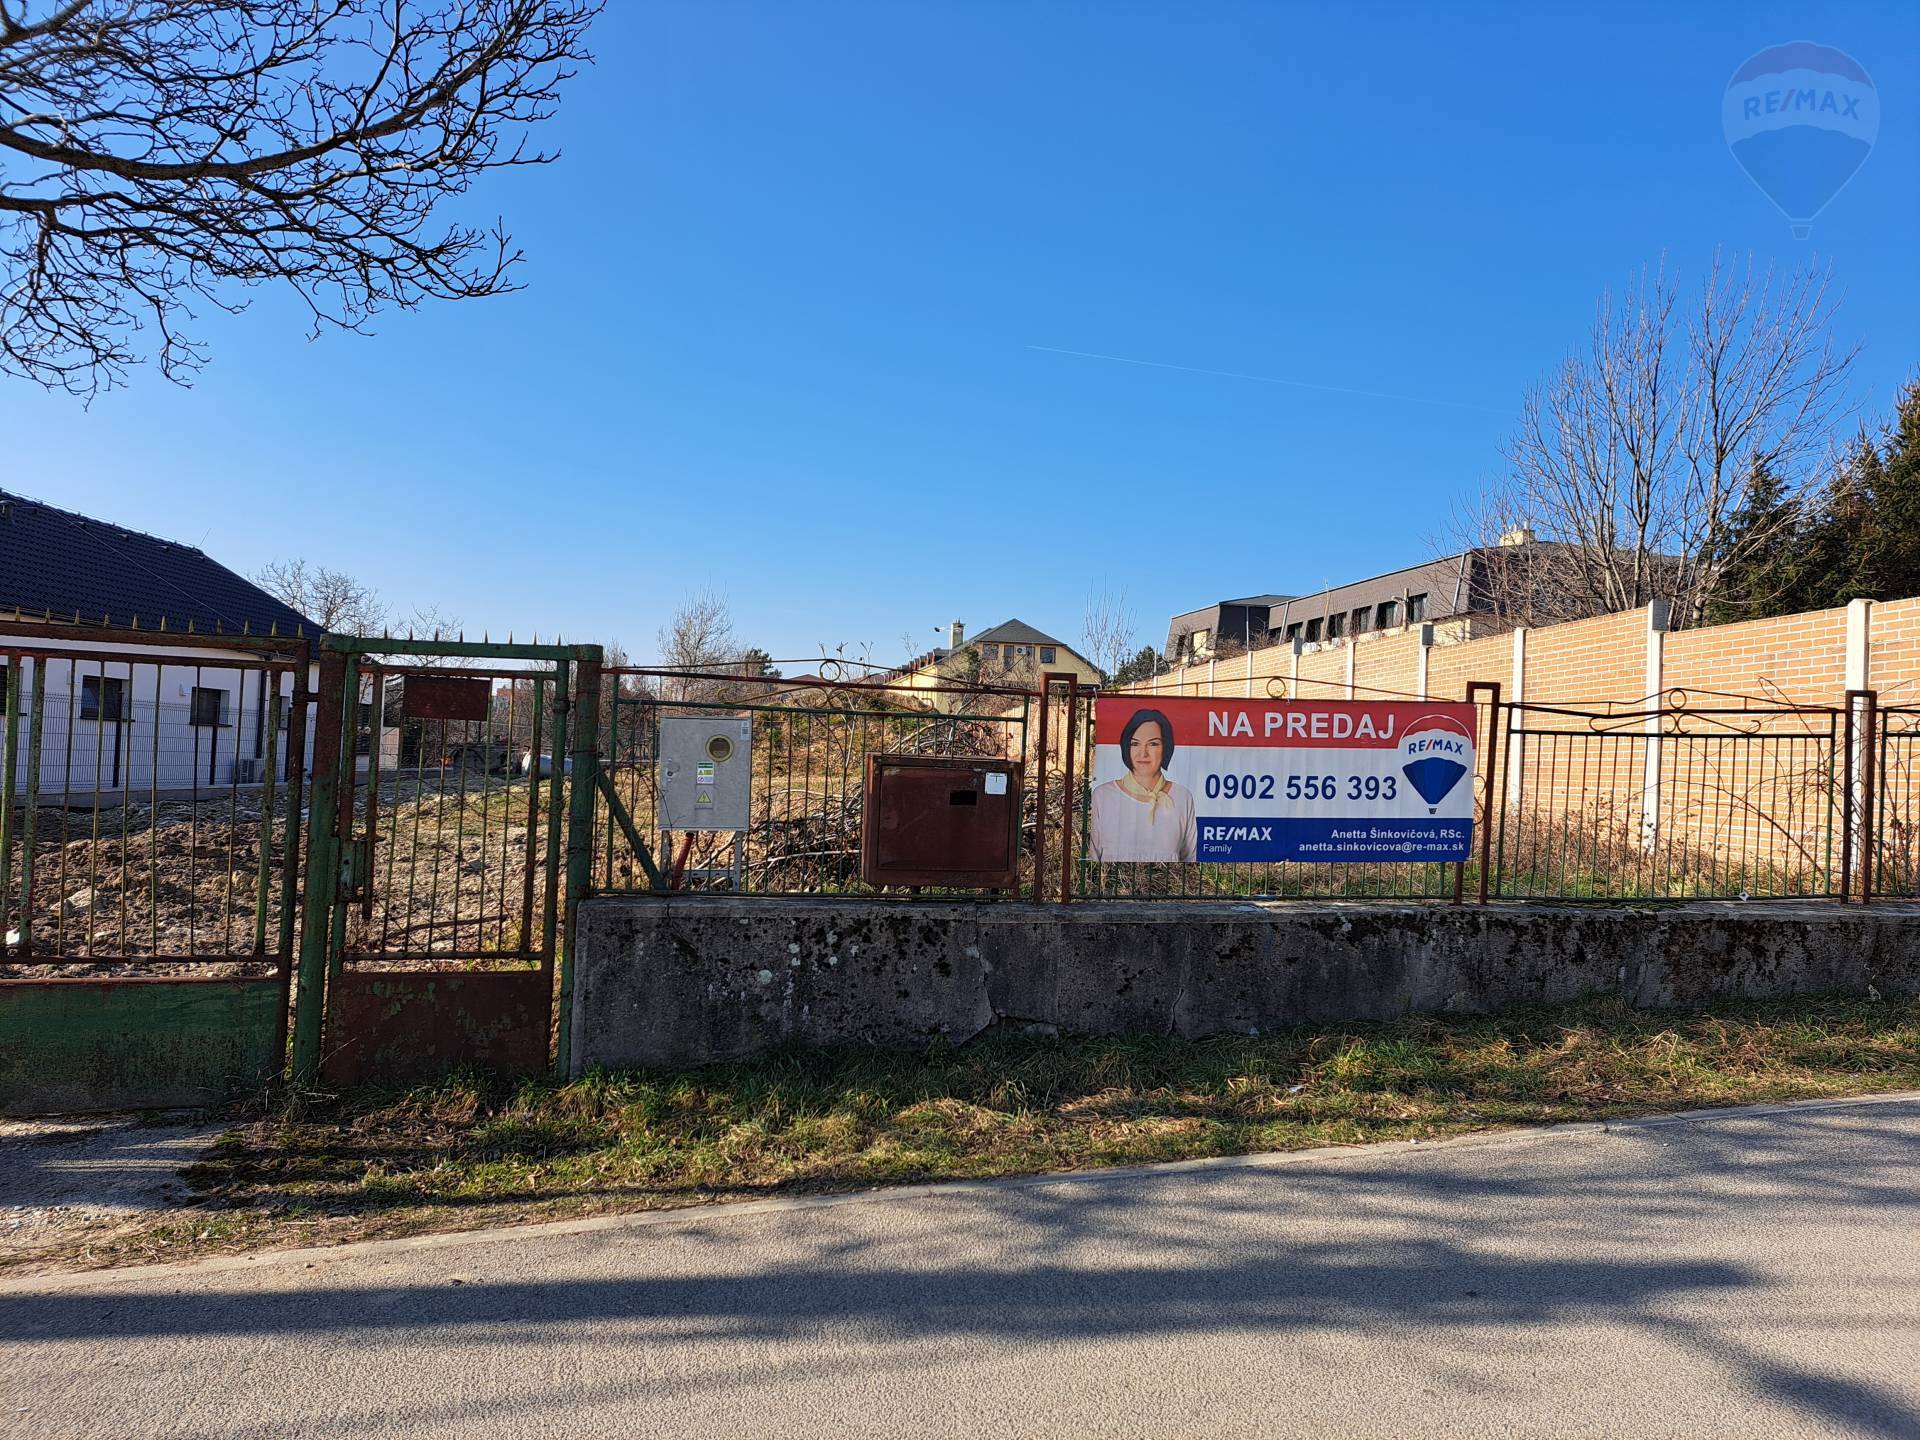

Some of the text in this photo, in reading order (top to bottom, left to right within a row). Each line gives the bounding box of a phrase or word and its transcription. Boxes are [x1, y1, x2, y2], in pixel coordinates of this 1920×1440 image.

[1208, 711, 1395, 740] NA PREDAJ
[1408, 738, 1464, 756] RE/MAX
[1204, 773, 1398, 801] 0902 556 393
[1203, 826, 1272, 841] RE/MAX
[1331, 826, 1465, 840] Anetta Šinkovičová, RSc.
[1203, 843, 1233, 855] Family
[1299, 841, 1465, 854] anetta.sinkovicova@re-max.sk
